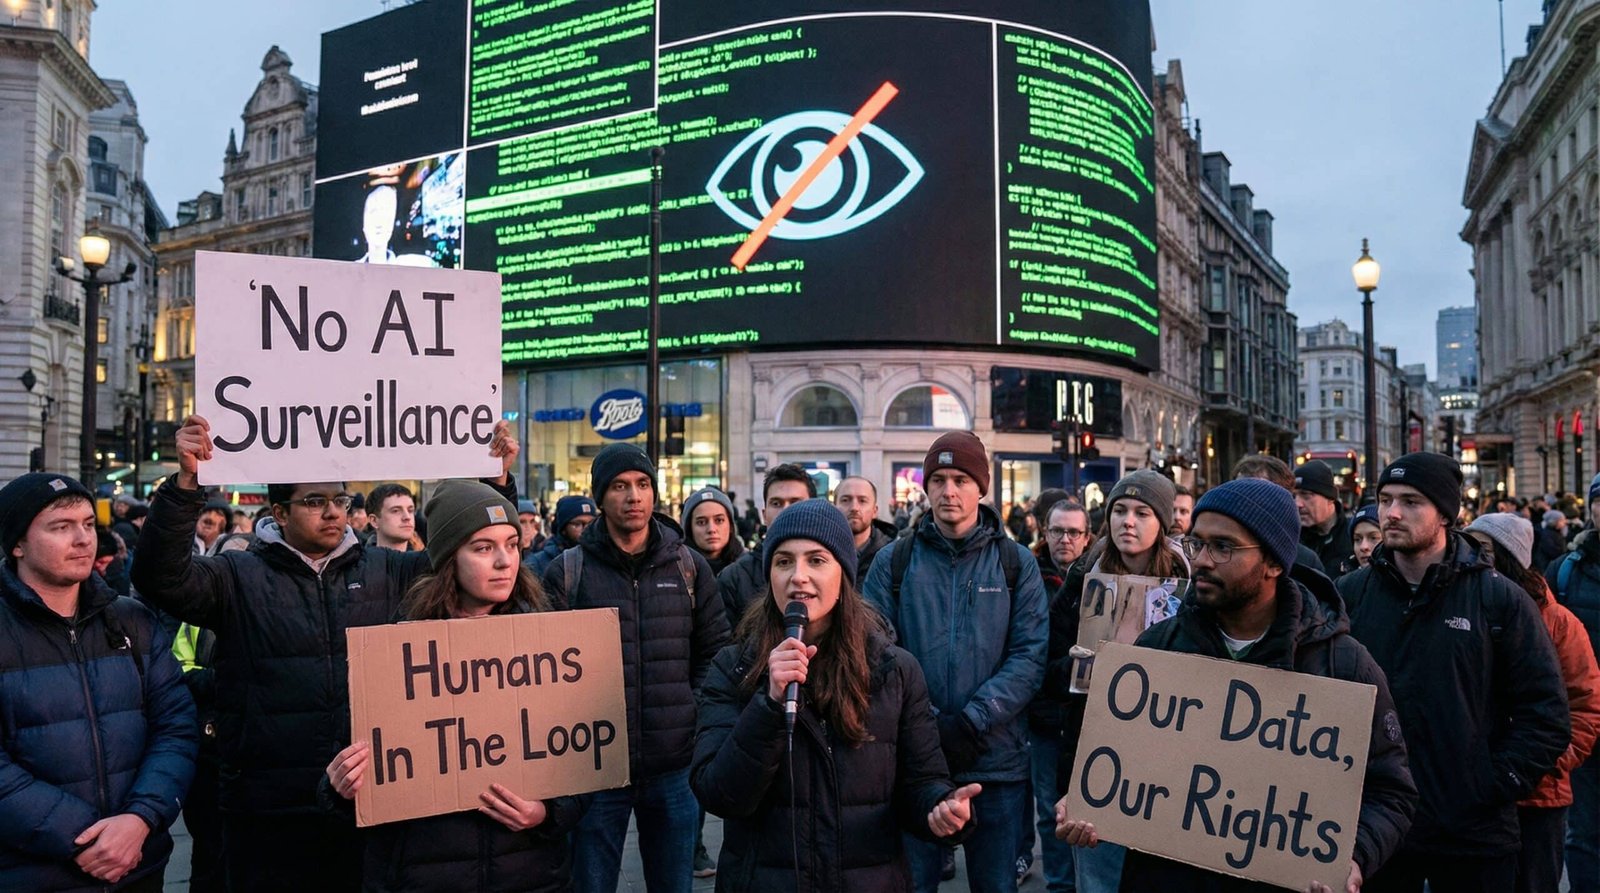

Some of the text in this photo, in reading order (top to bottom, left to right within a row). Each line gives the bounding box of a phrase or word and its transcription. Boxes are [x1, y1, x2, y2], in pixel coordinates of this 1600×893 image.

[371, 289, 455, 357] AI
[593, 396, 645, 432] Boots
[402, 639, 583, 700] Humans
[372, 707, 617, 786] In The Loop
[1107, 662, 1355, 772] Our Data,
[1080, 746, 1342, 870] Our Rights
